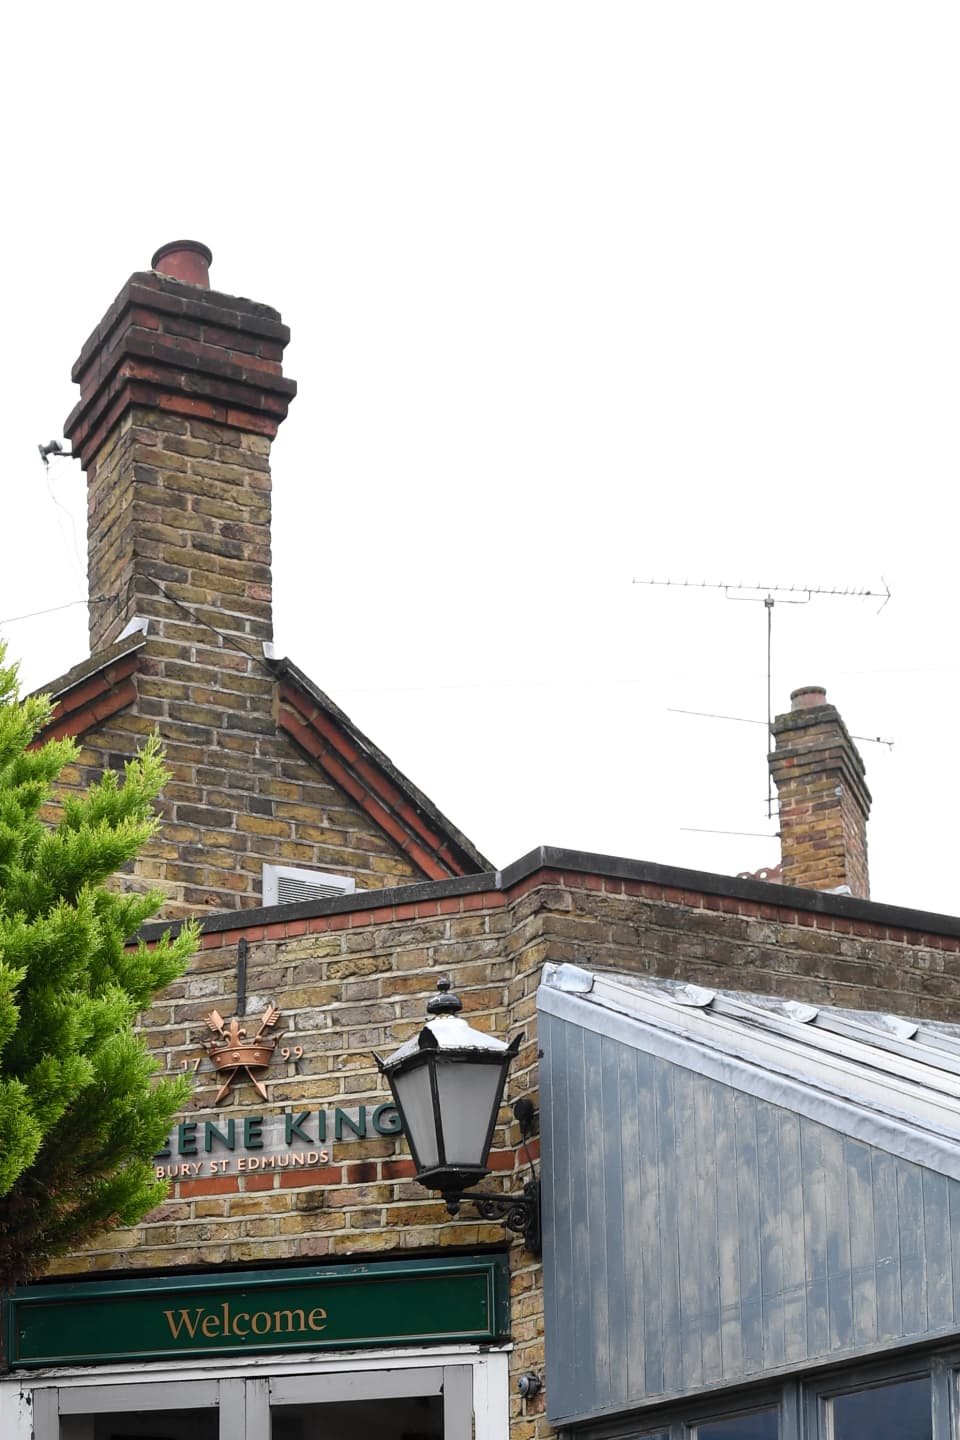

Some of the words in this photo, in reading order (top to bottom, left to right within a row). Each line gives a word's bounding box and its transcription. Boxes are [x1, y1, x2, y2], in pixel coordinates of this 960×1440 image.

[180, 1058, 201, 1071] 17
[281, 1046, 304, 1060] 99
[285, 1103, 402, 1144] KING
[156, 1161, 203, 1179] BURY
[210, 1159, 230, 1173] ST
[238, 1151, 329, 1171] EDMUNDS
[162, 1302, 328, 1340] Welcome
